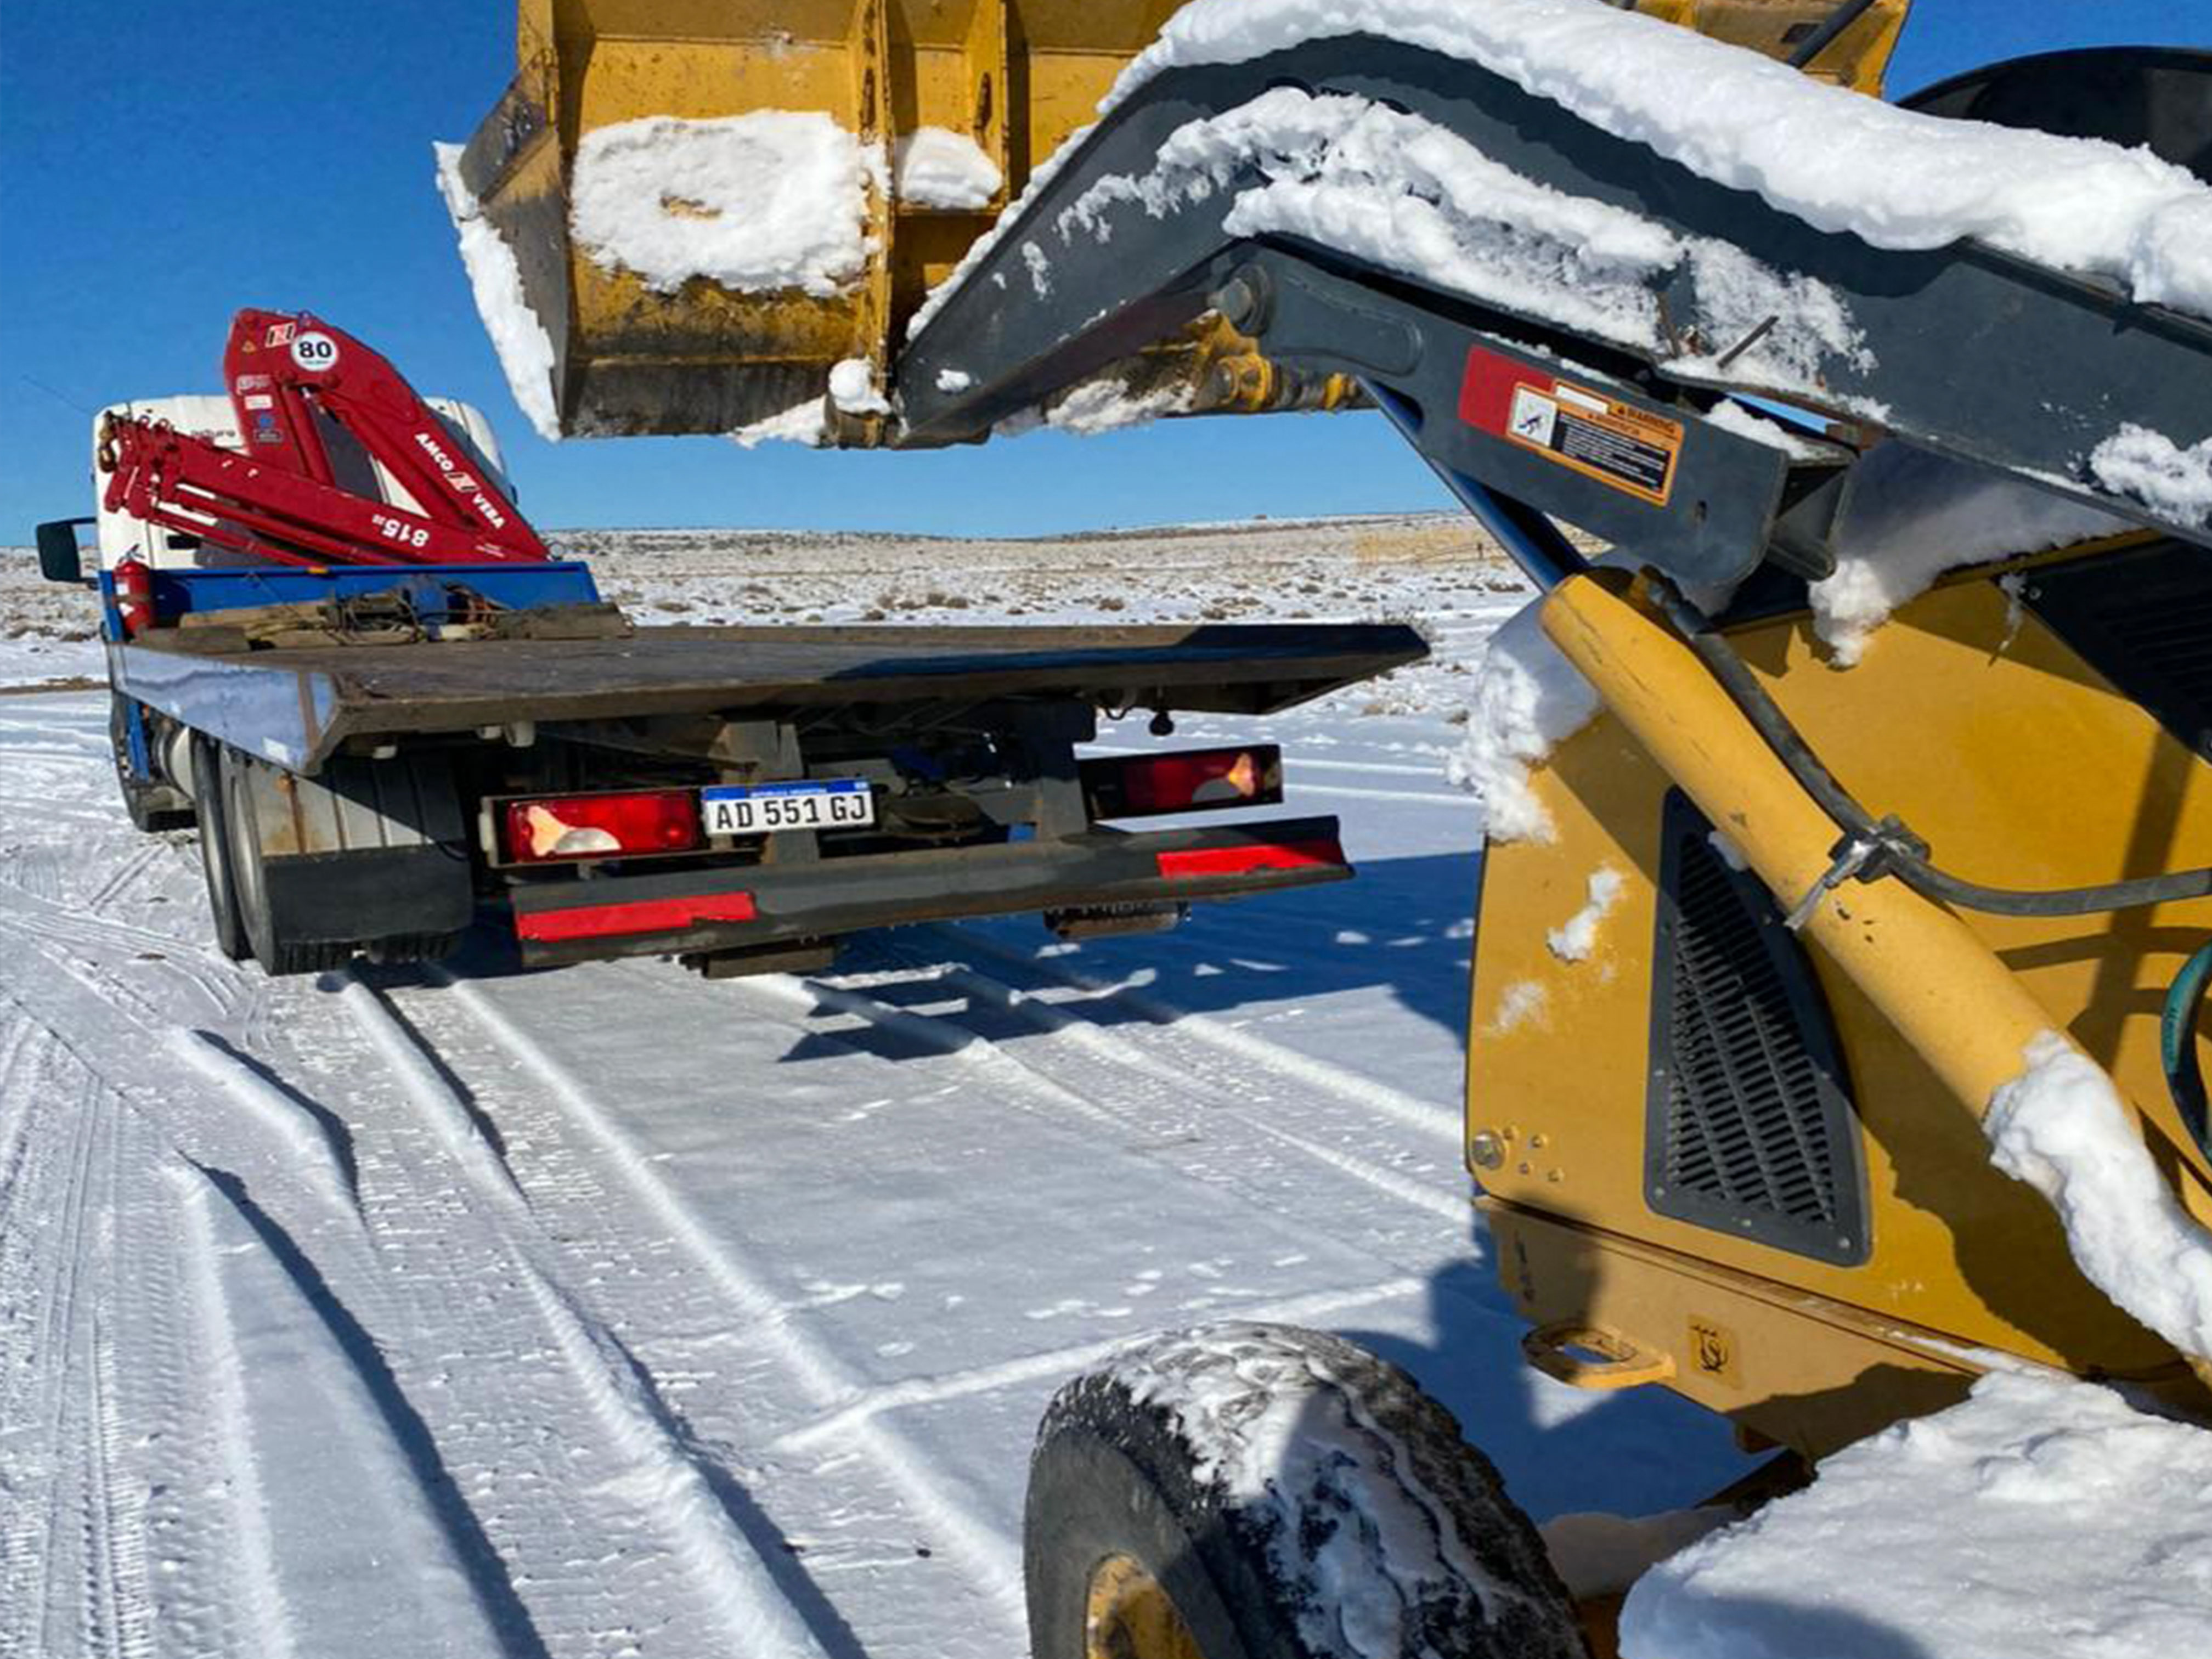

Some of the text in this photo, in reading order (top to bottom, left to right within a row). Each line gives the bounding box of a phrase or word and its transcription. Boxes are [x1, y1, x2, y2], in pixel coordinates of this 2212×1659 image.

[298, 341, 332, 358] 80
[415, 432, 454, 472] AMCO
[472, 493, 506, 529] VEBA
[381, 518, 430, 548] 815
[716, 795, 866, 830] AD 551 GJ
